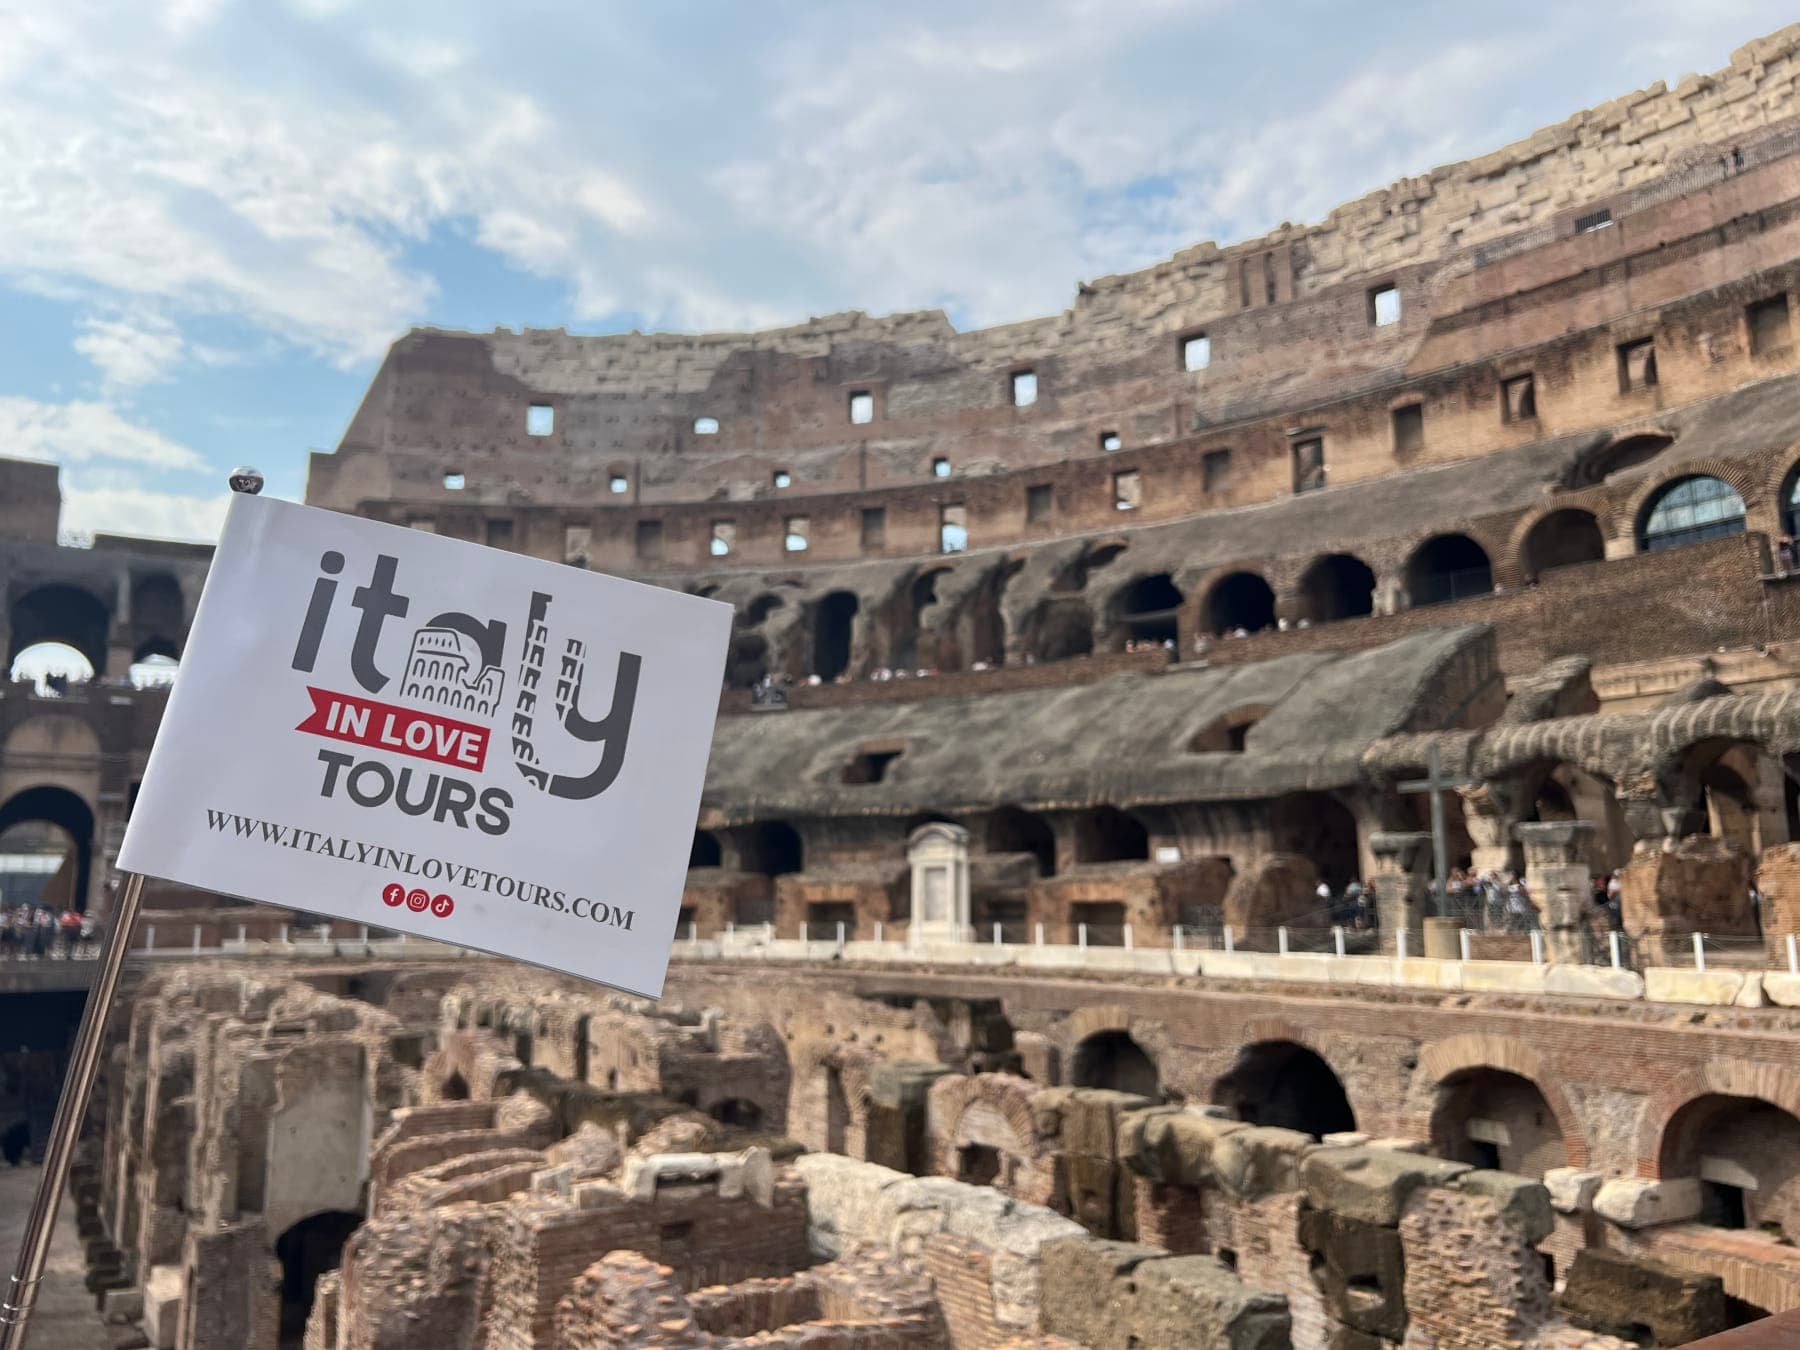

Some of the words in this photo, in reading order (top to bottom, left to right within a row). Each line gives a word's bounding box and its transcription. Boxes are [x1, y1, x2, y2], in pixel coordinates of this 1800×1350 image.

[291, 551, 642, 801] italy
[325, 701, 371, 738] IN
[382, 714, 483, 765] LOVE
[317, 750, 514, 836] TOURS
[206, 809, 636, 931] WWW.ITALYINLOVETOURS.COM
